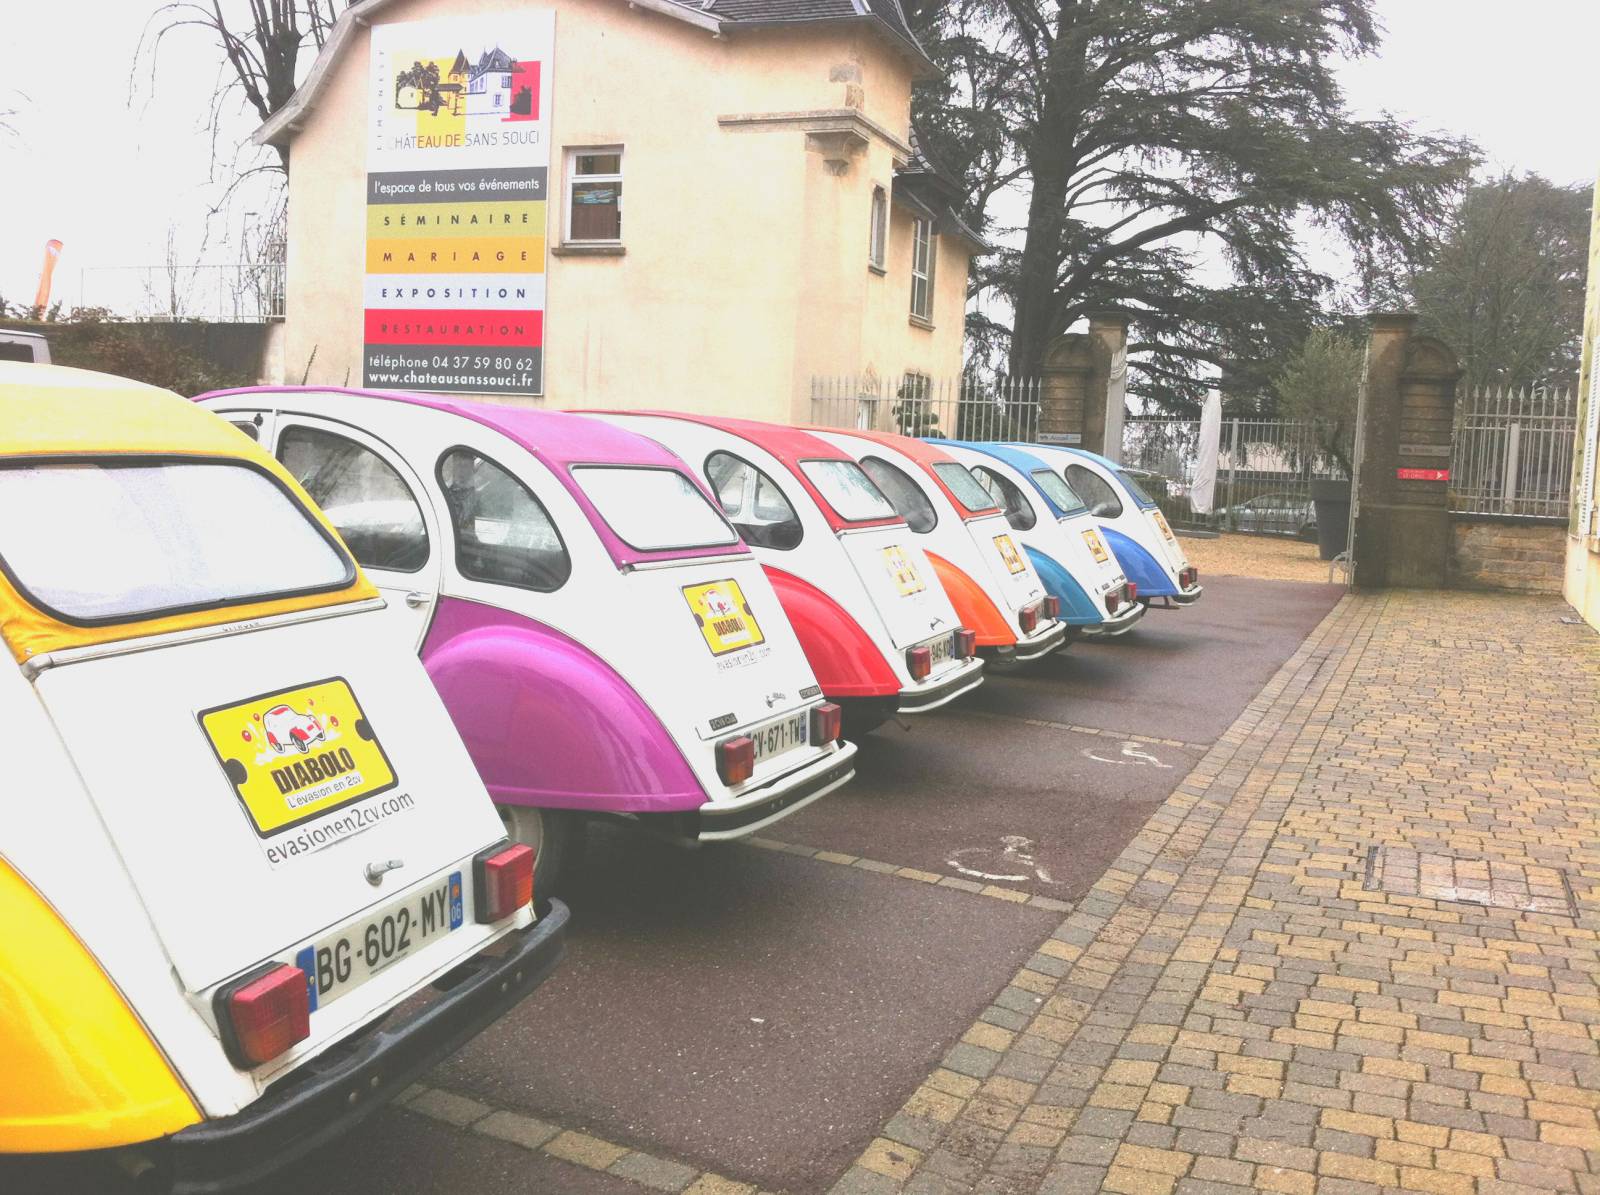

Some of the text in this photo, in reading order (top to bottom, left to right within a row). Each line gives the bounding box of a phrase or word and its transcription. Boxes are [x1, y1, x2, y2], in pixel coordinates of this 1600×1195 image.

[390, 130, 540, 150] HÂTEAU DE SANS SOUCI
[374, 179, 540, 196] l'espace de tous vos événements
[384, 213, 529, 226] SÉMINAIRE
[383, 251, 527, 262] MARIAGE
[382, 288, 526, 298] EXPOSITION
[381, 323, 525, 335] RESTAURATION
[369, 355, 533, 371] téléphone 04 37 59 80 62
[369, 370, 533, 387] www.chateausanssouci.fr
[270, 747, 356, 795] DIABOLO
[334, 781, 346, 795] en
[266, 791, 415, 864] evasionen2cv.com
[450, 906, 462, 922] 06
[316, 885, 448, 996] BG-602-MY
